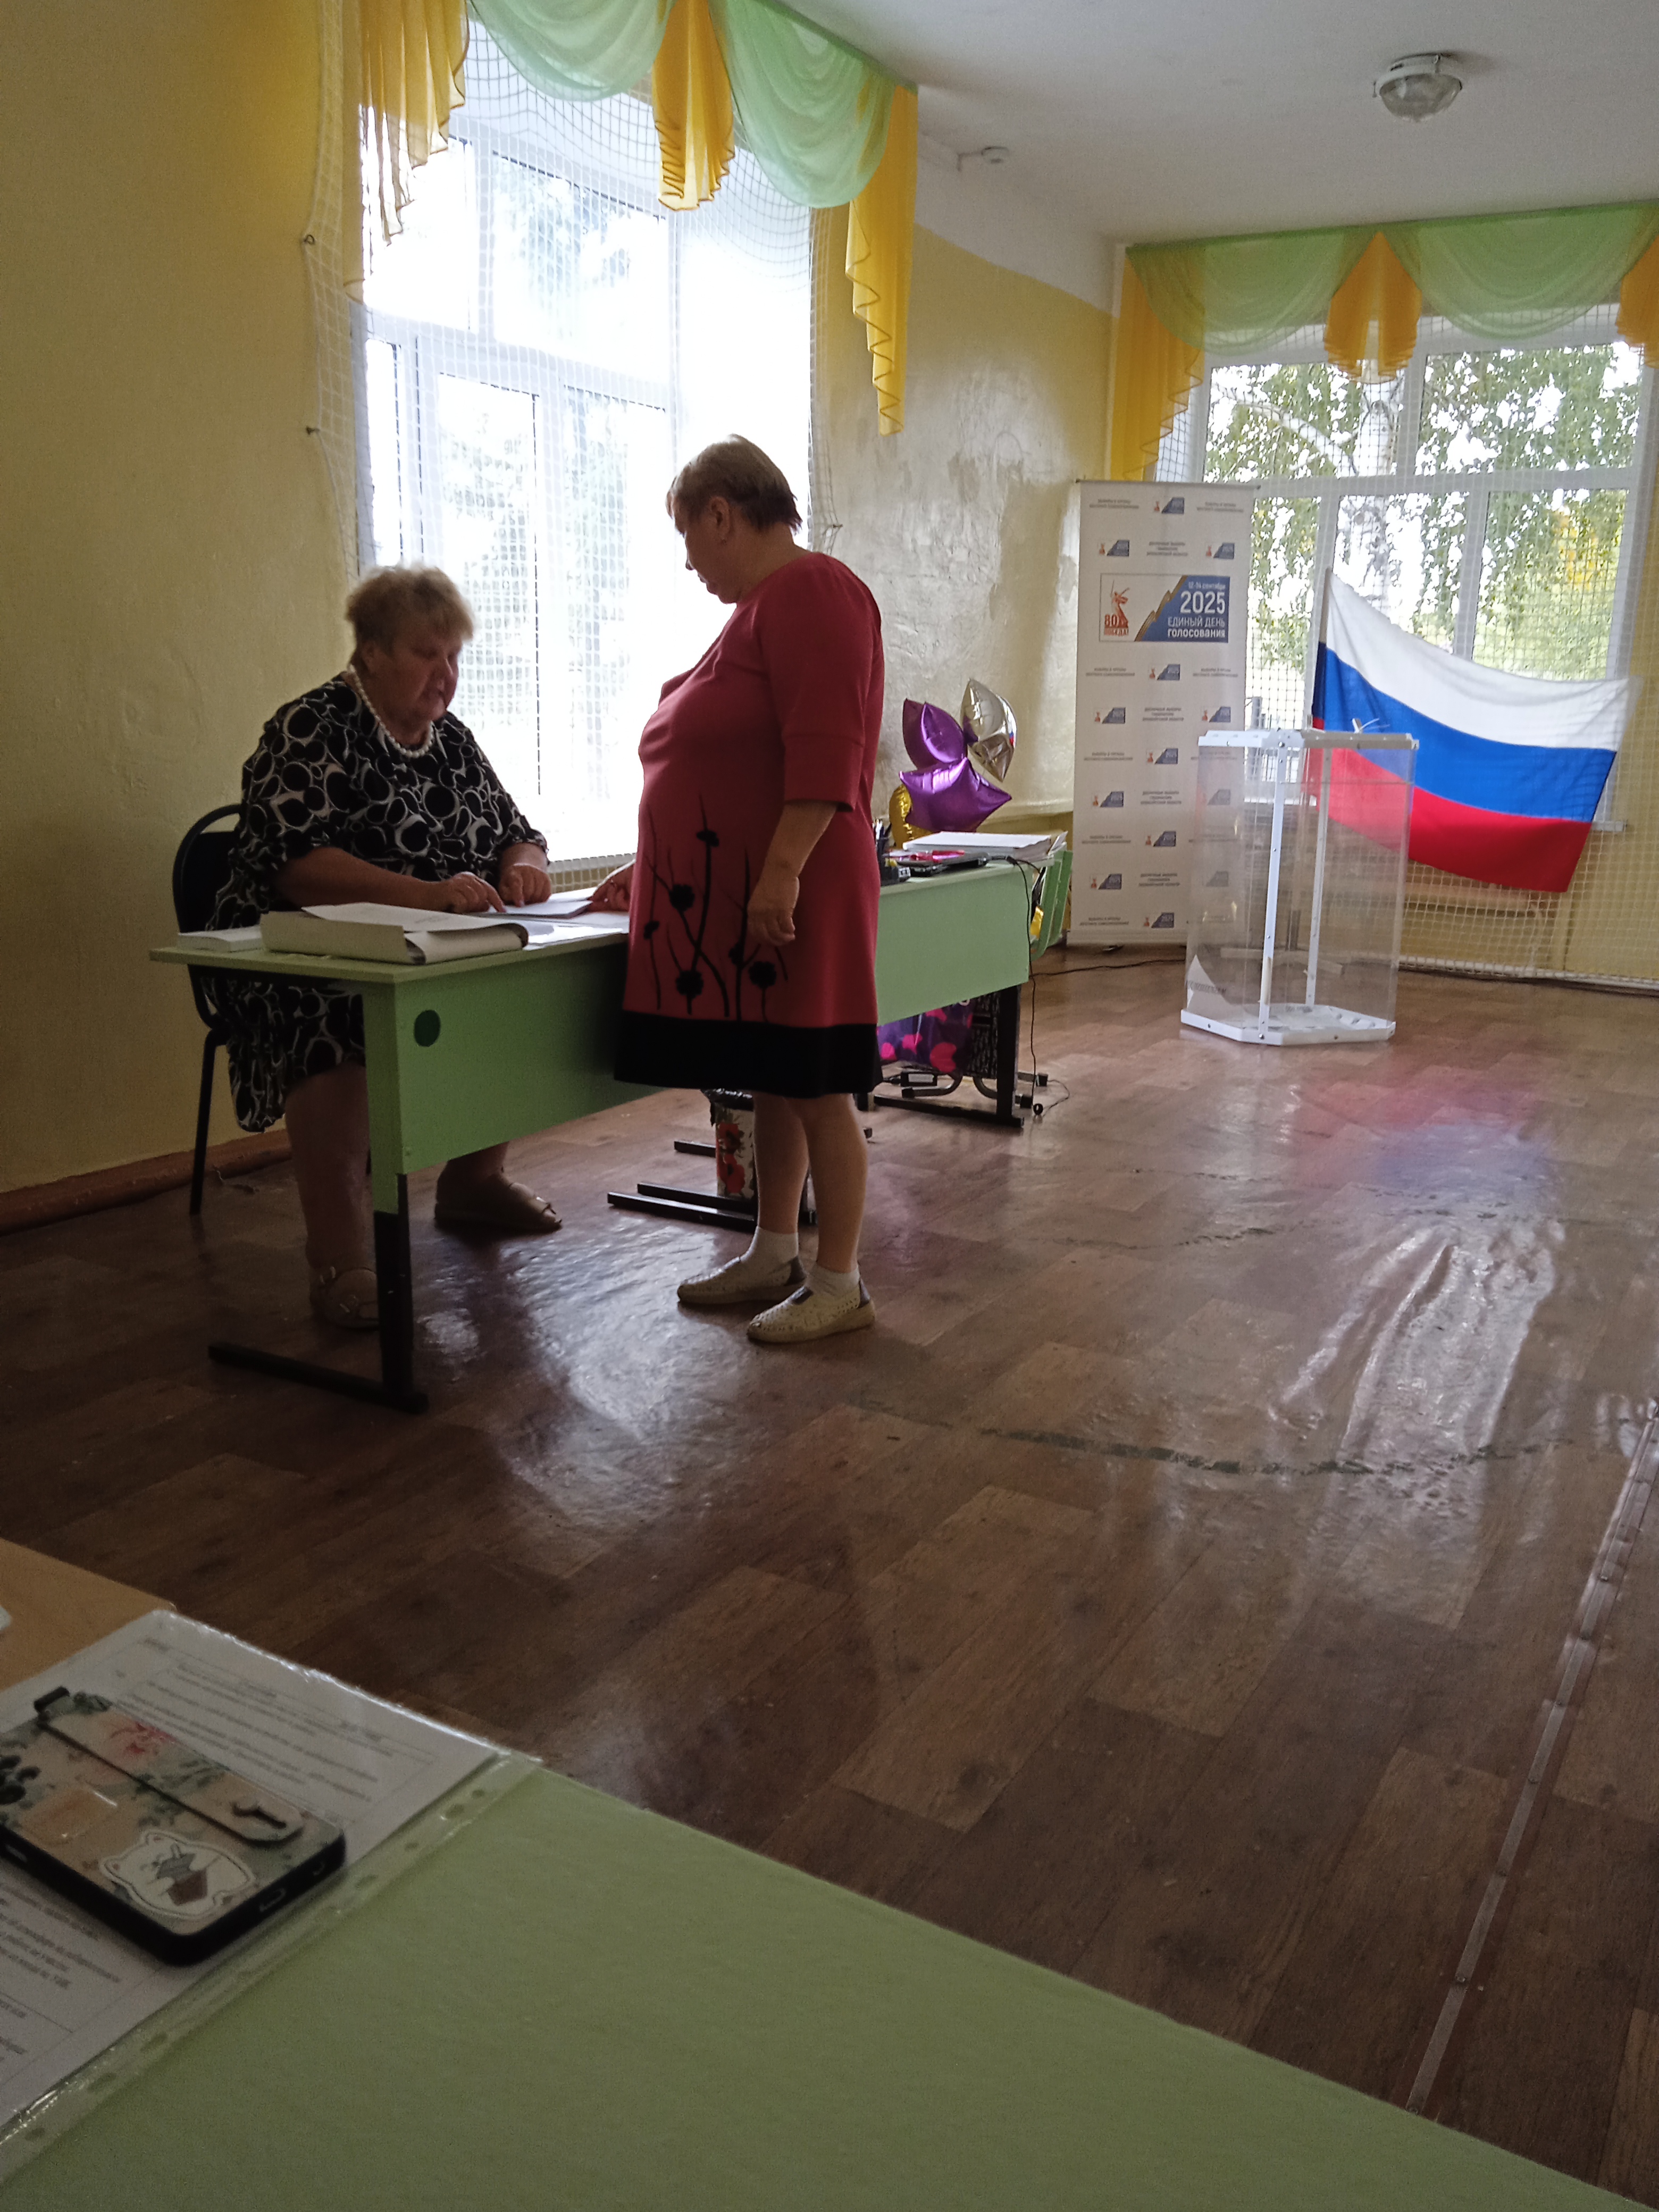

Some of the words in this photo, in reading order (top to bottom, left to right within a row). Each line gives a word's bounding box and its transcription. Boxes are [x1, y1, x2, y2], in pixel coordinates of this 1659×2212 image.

[1180, 591, 1226, 615] 2025
[1168, 615, 1203, 627] ЕДИНЫЙ
[1204, 617, 1226, 627] ДЕНЬ
